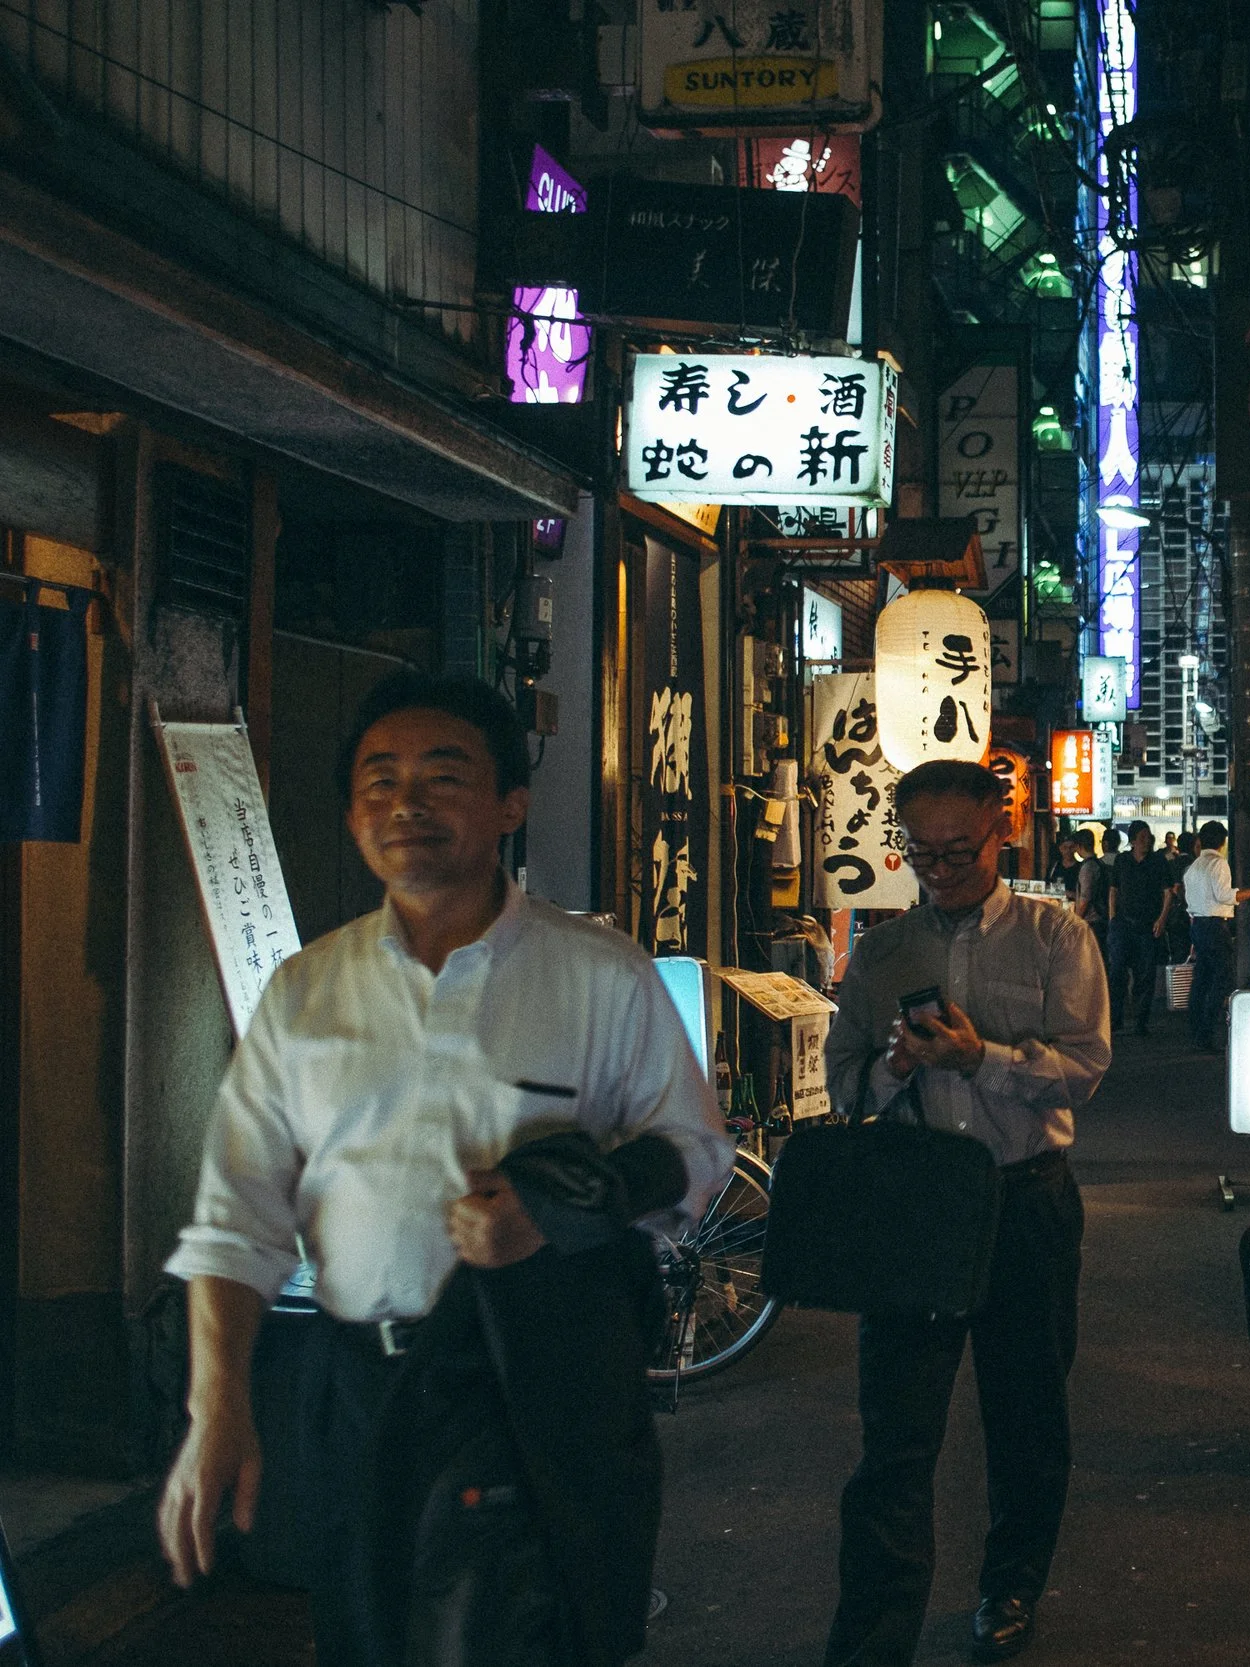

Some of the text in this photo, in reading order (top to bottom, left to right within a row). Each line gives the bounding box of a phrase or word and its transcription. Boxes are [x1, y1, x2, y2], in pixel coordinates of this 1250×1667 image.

[685, 69, 816, 91] SUNTORY
[642, 425, 869, 486] 蛇の新
[820, 774, 836, 846] BANCHO
[822, 697, 884, 895] はんちょう
